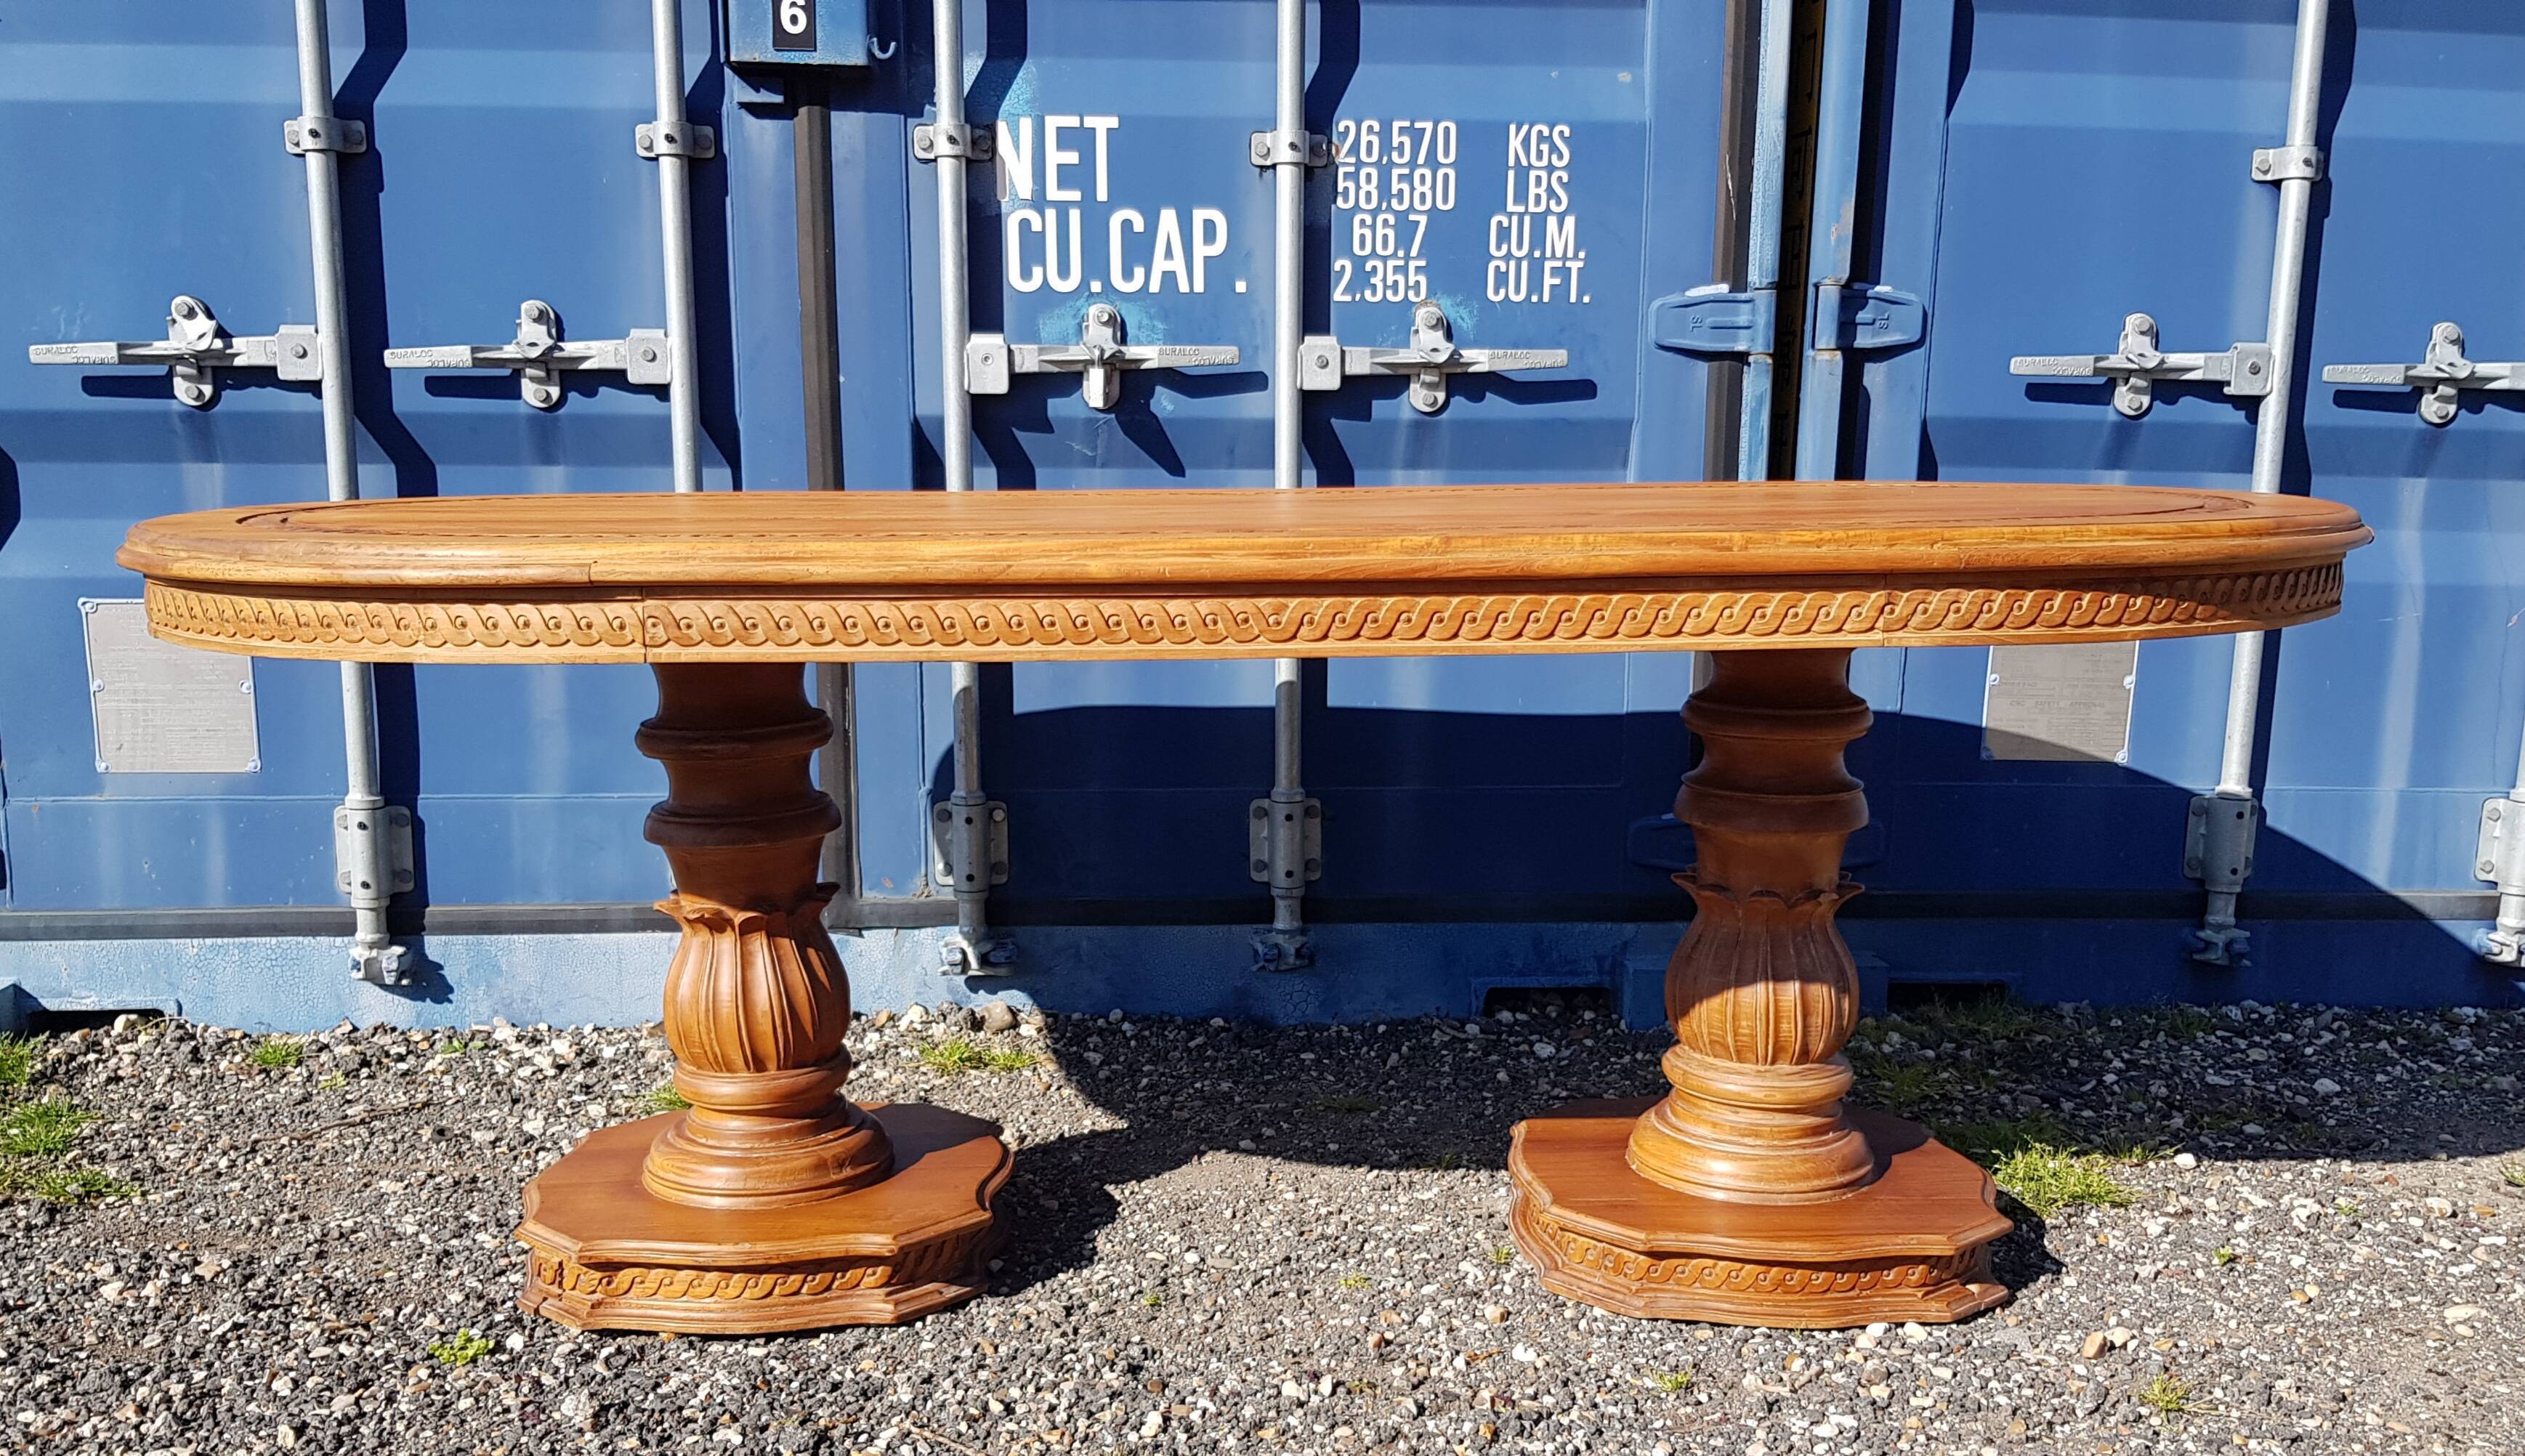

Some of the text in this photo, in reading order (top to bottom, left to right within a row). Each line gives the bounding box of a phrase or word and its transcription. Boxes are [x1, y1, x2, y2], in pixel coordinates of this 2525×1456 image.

[780, 0, 806, 34] 6
[996, 116, 1119, 202] NET
[1338, 120, 1570, 168] 26,570 KGS
[1336, 166, 1569, 213] 58,580 LBS
[1352, 214, 1586, 259] 66.7 CU.M.
[1333, 260, 1591, 303] 2,355 CU.FT.
